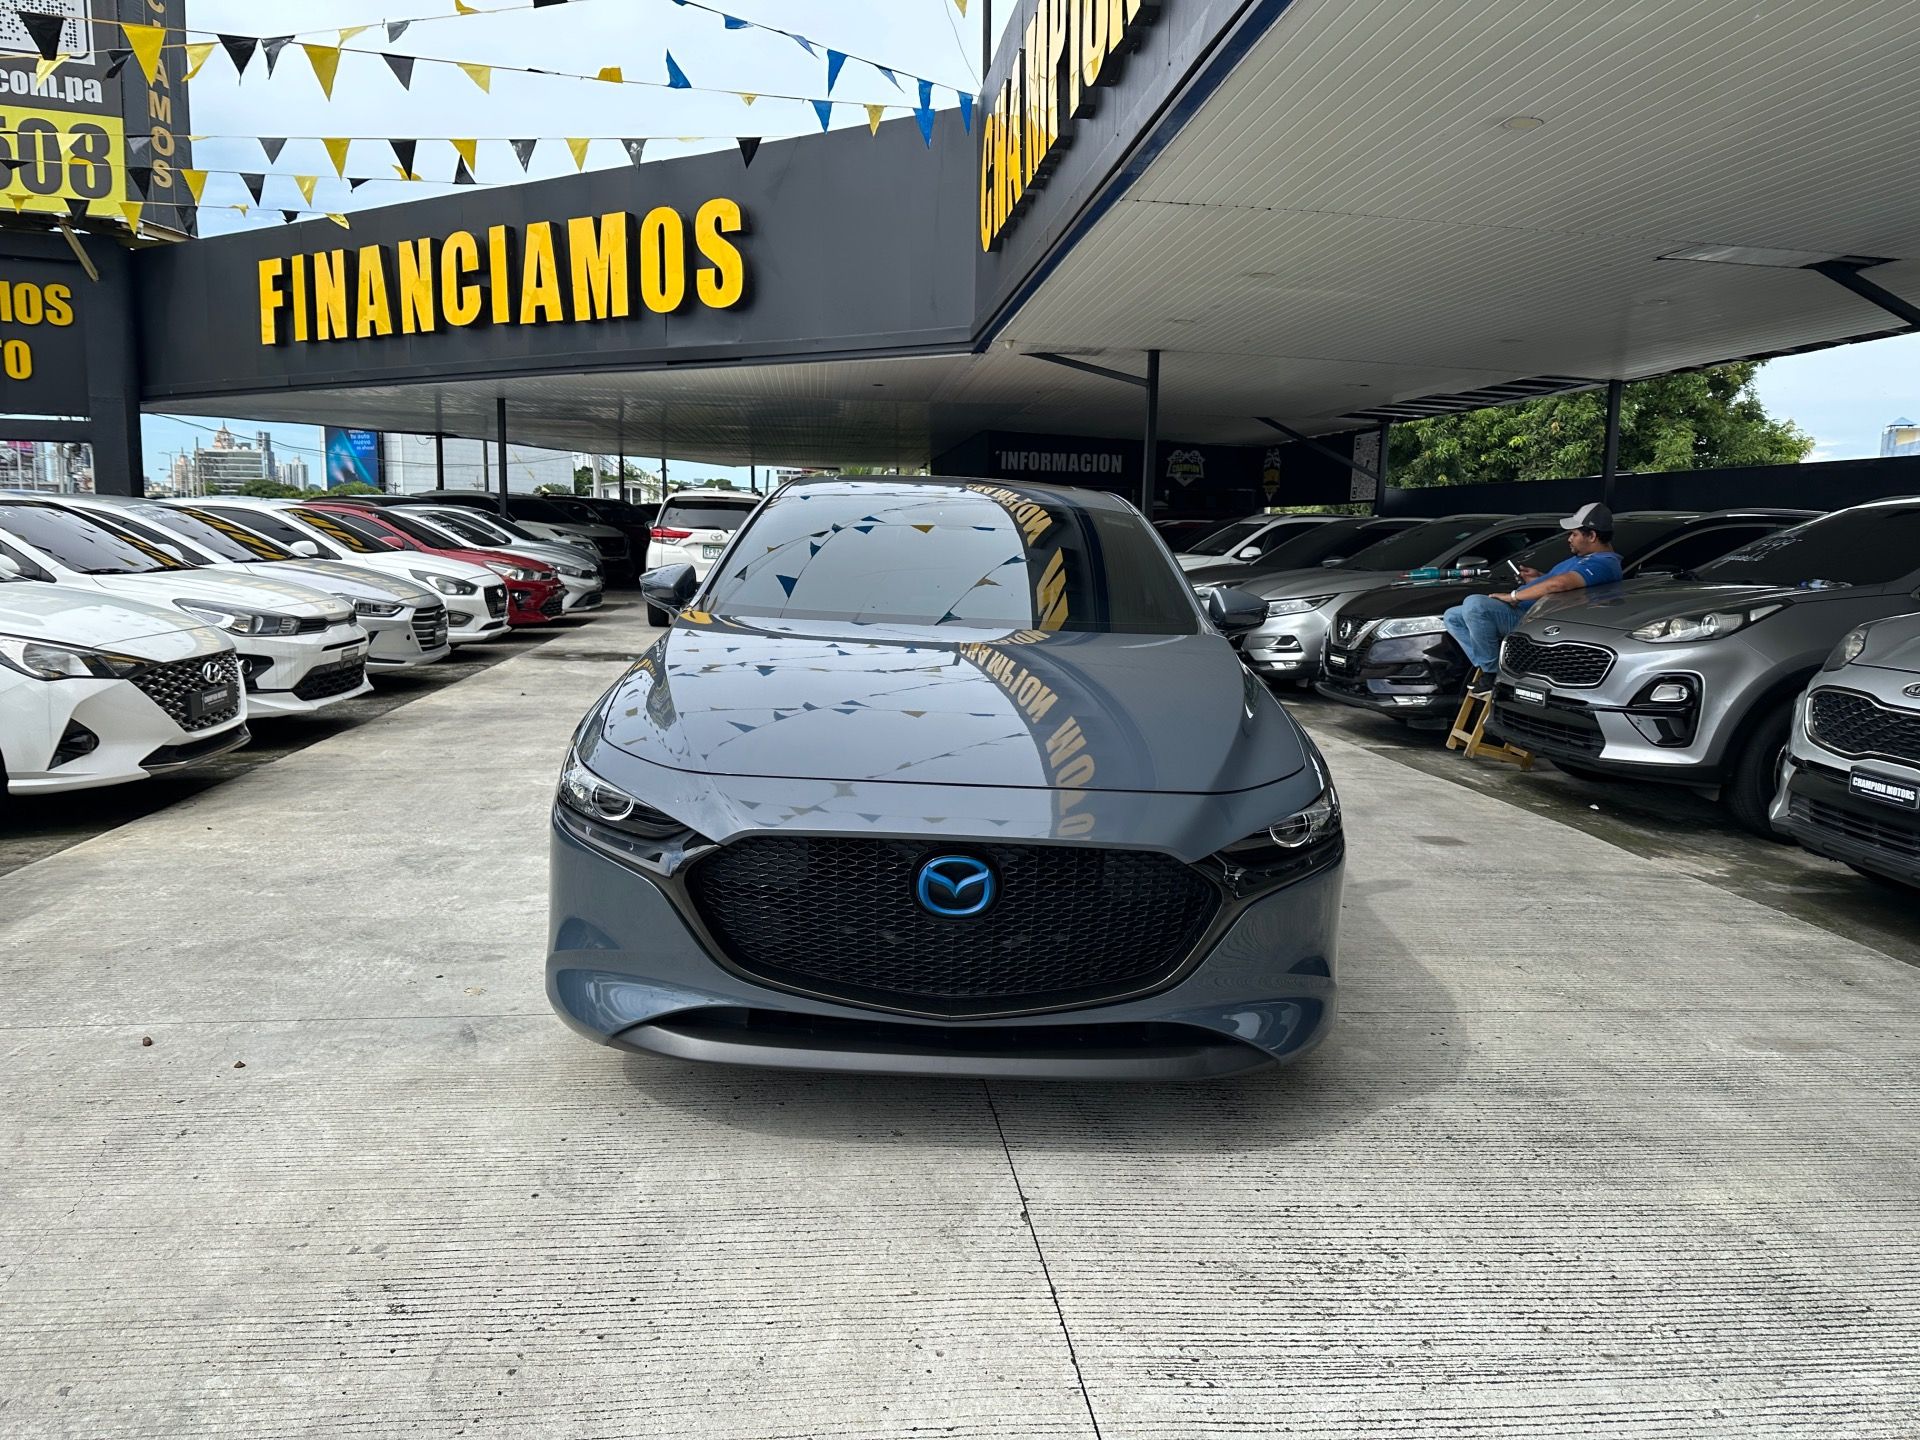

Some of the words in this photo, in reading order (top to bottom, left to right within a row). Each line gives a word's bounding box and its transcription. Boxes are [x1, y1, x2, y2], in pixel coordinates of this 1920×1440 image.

[980, 0, 1141, 253] CHAMPI
[258, 197, 744, 345] FINANCIAMOS
[1001, 450, 1123, 473] INFORMACION
[1852, 776, 1886, 793] CHAMPION
[1886, 785, 1916, 801] MOTORS
